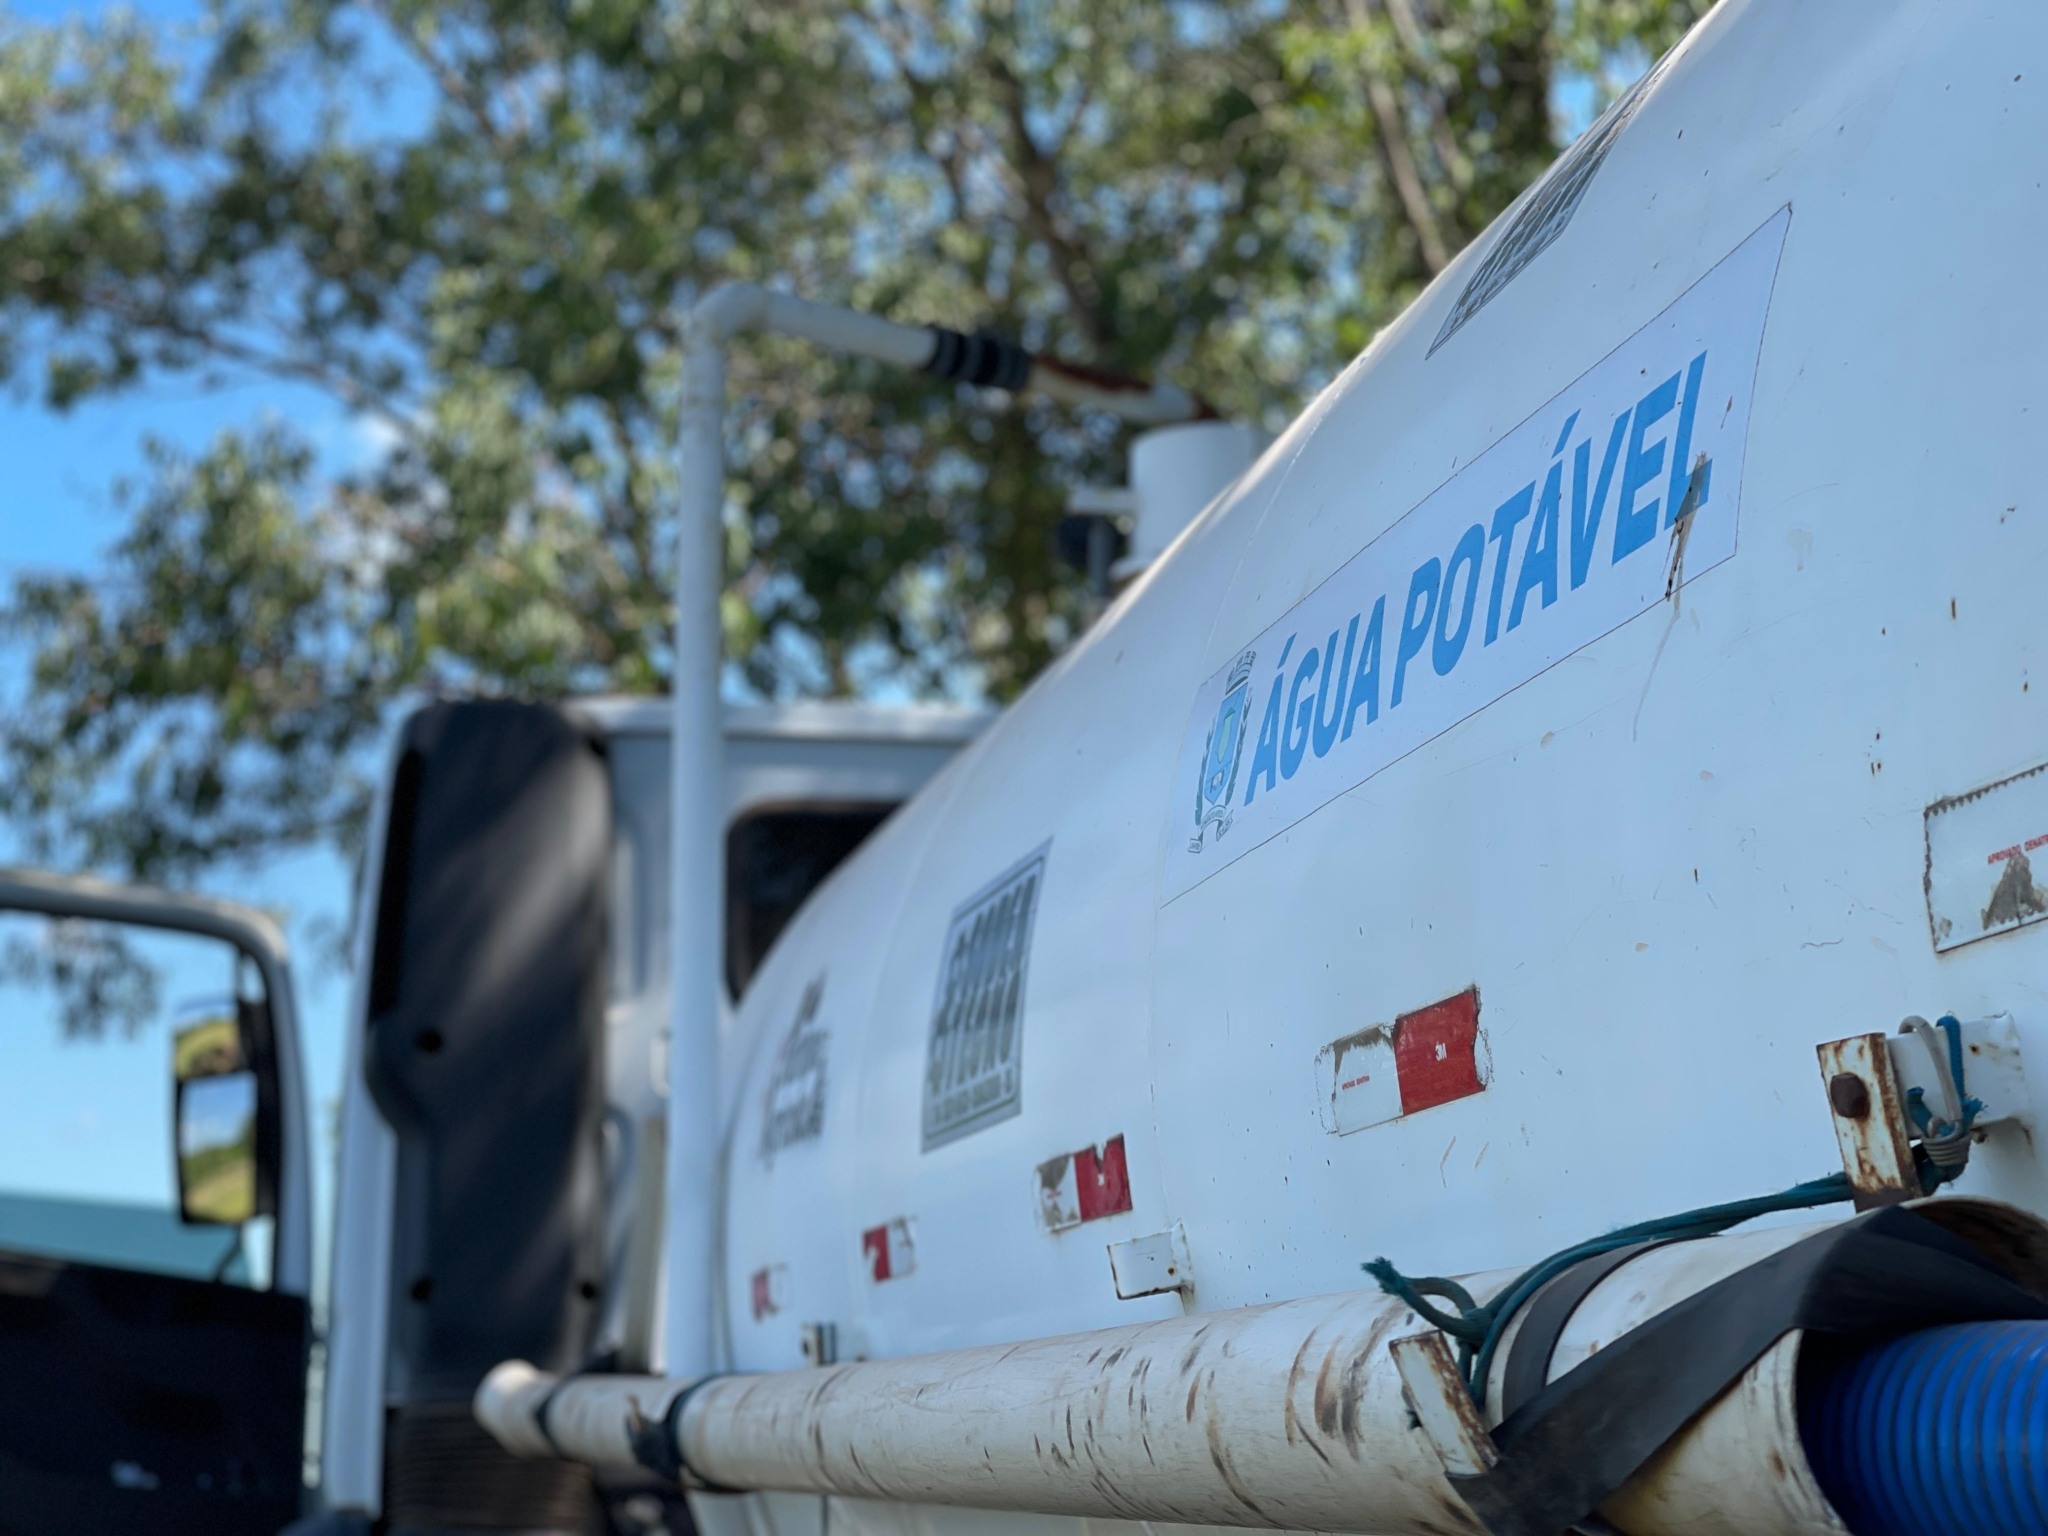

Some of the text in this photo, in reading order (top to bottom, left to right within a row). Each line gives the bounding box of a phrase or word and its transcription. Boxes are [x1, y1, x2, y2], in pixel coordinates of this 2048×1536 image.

[1244, 350, 1713, 807] ÁGUA POTÁVEL
[1435, 1042, 1447, 1061] 3M
